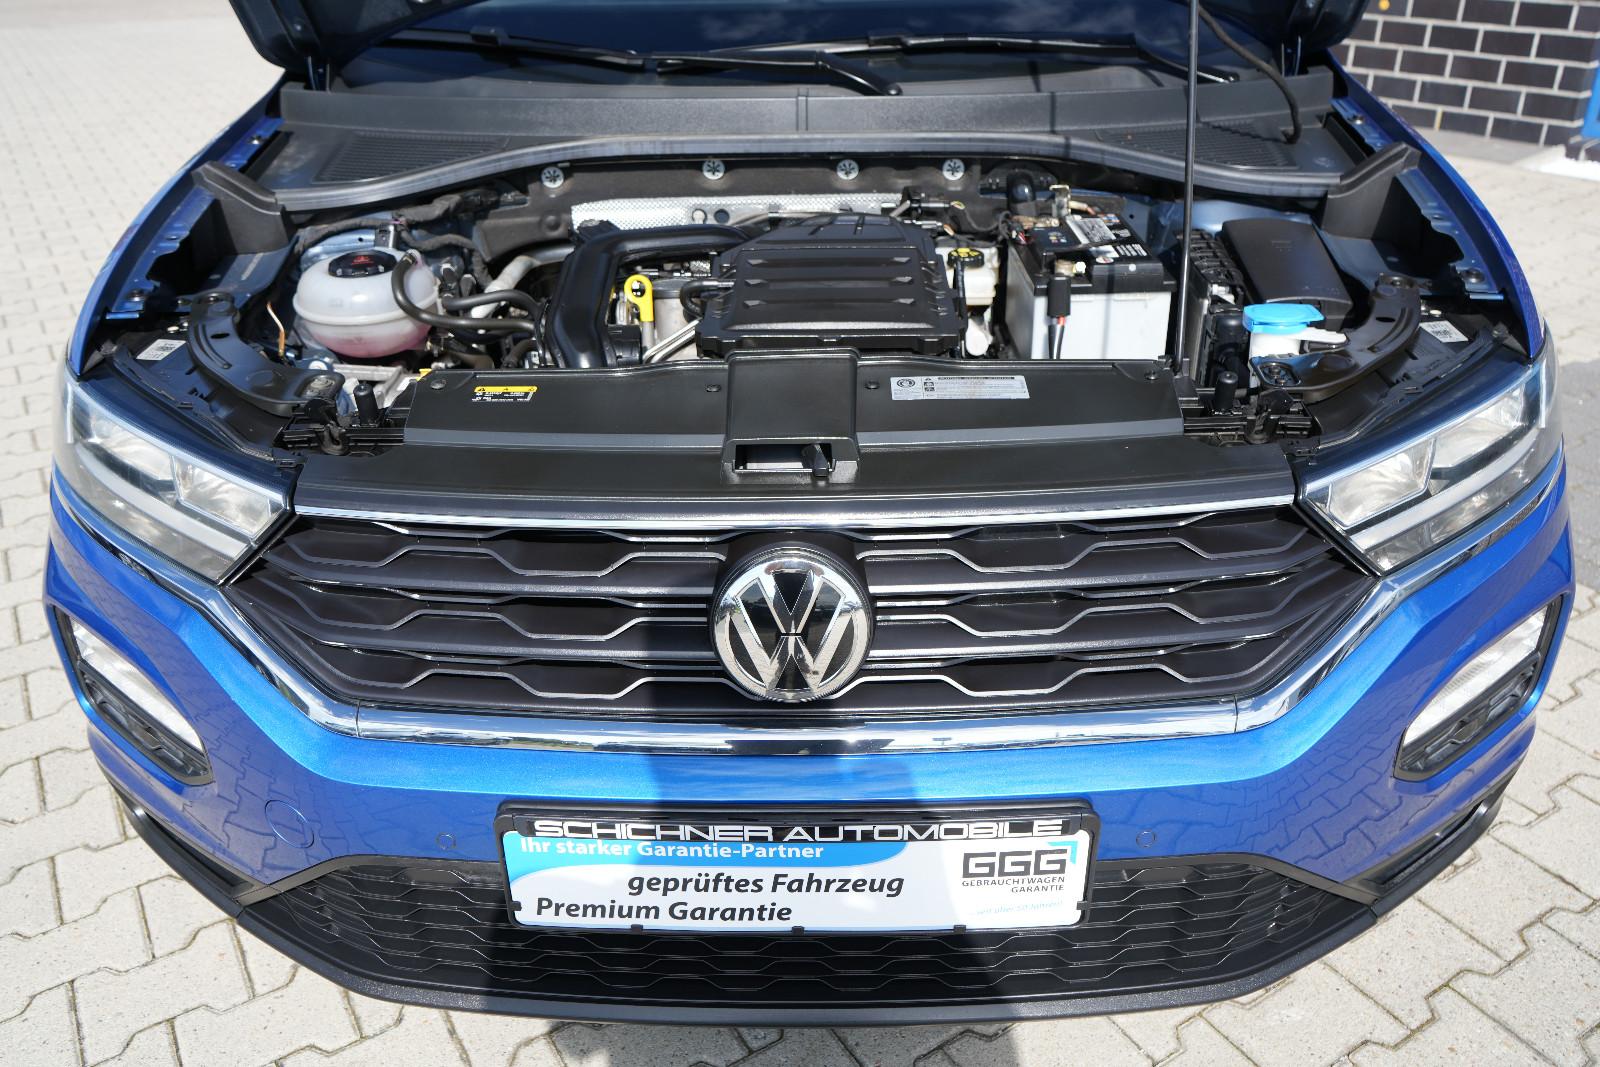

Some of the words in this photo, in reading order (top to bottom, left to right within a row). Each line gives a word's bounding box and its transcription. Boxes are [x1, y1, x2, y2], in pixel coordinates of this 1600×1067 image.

[534, 820, 774, 842] SCHICHNER
[783, 819, 1063, 842] AUTOMOBILE
[520, 837, 550, 853] Ihr
[556, 838, 632, 857] starker
[636, 841, 824, 859] Garantie-Partner
[962, 848, 1068, 878] GGG
[627, 872, 764, 897] geprüftes
[771, 873, 905, 898] Fahrzeug
[961, 876, 1066, 888] GEBRAUCHTWAGEN
[1011, 884, 1066, 894] GARANTIE
[536, 897, 661, 921] Premium
[668, 901, 793, 922] Garantie
